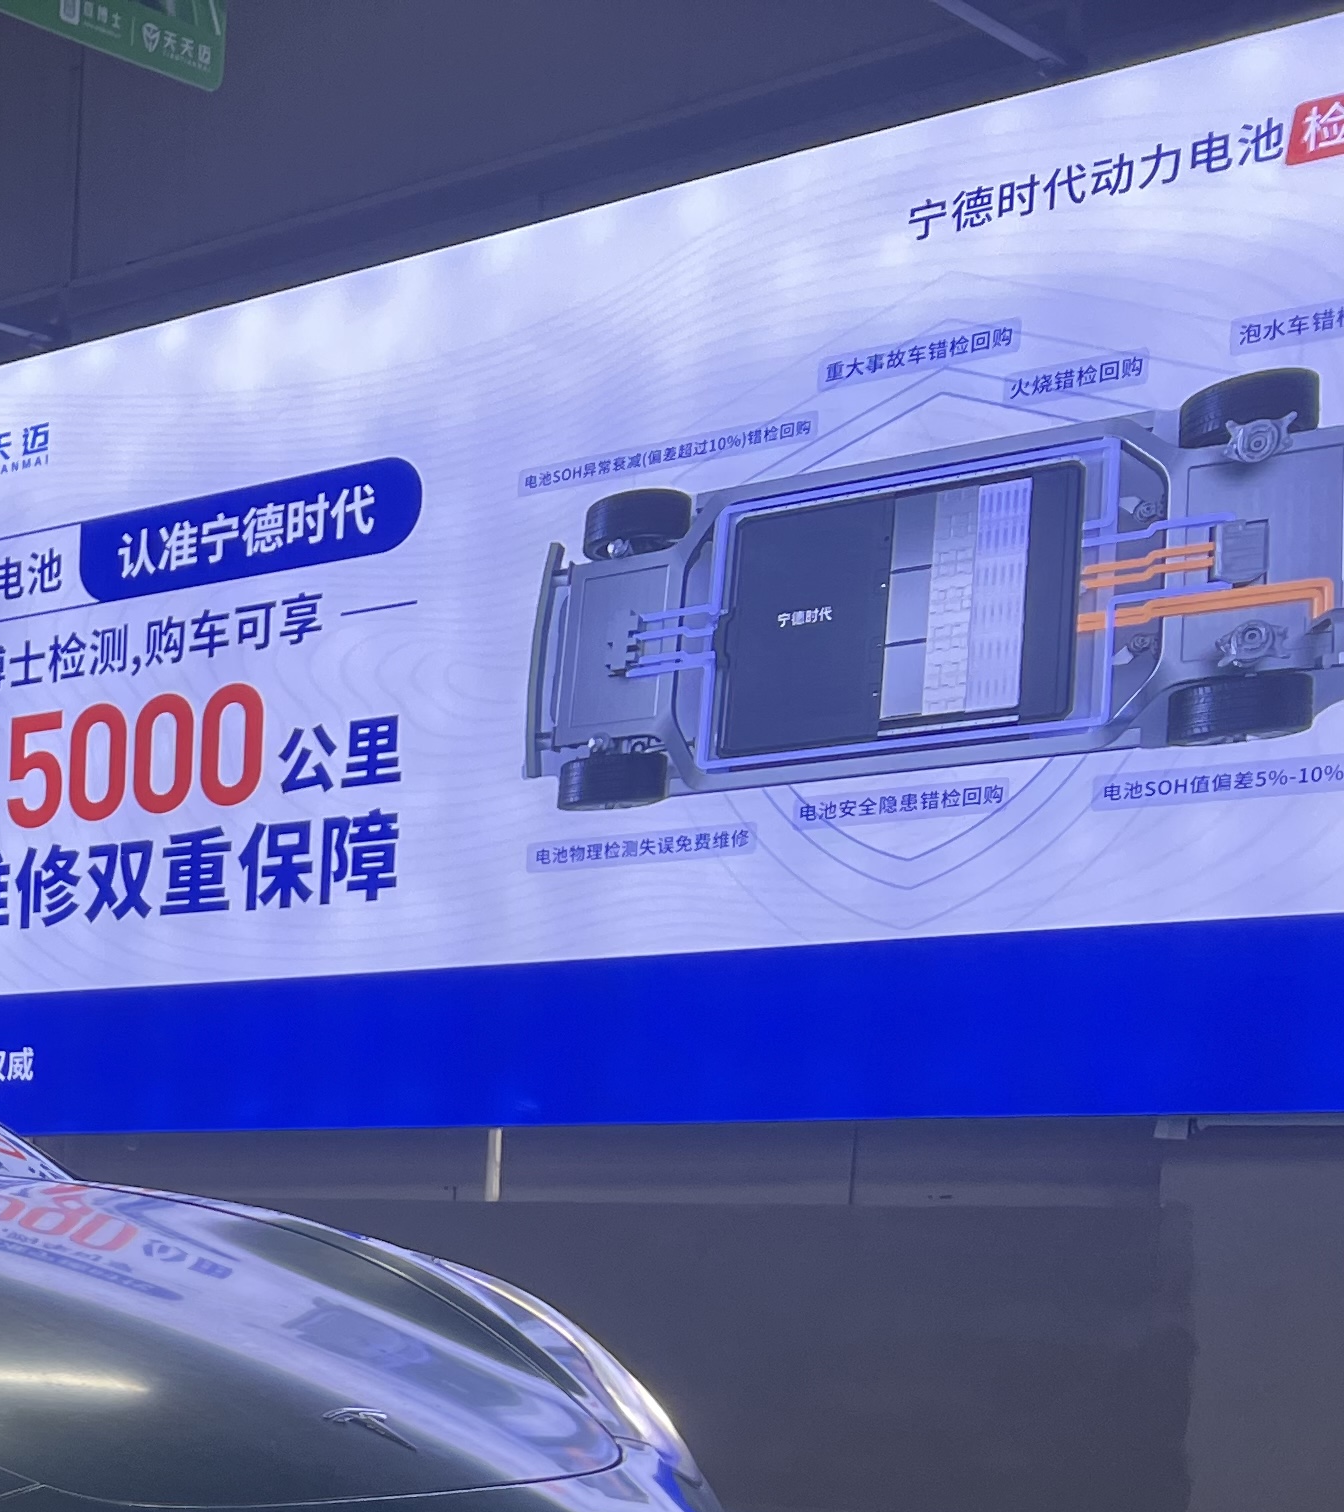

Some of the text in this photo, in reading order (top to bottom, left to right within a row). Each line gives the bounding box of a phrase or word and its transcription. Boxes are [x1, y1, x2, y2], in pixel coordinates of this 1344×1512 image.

[825, 326, 1013, 383] 重大事故车错检回购
[1009, 356, 1143, 399] 火烧错检回购
[524, 420, 812, 489] 电池SOH异常衰减(偏差超过10%)错检回购
[118, 485, 376, 579] 认准宁德时代
[777, 606, 833, 628] 宁德时代
[799, 785, 1005, 822] 电池安全隐患错检回购
[535, 829, 750, 865] 电池物理检测失误免费维修
